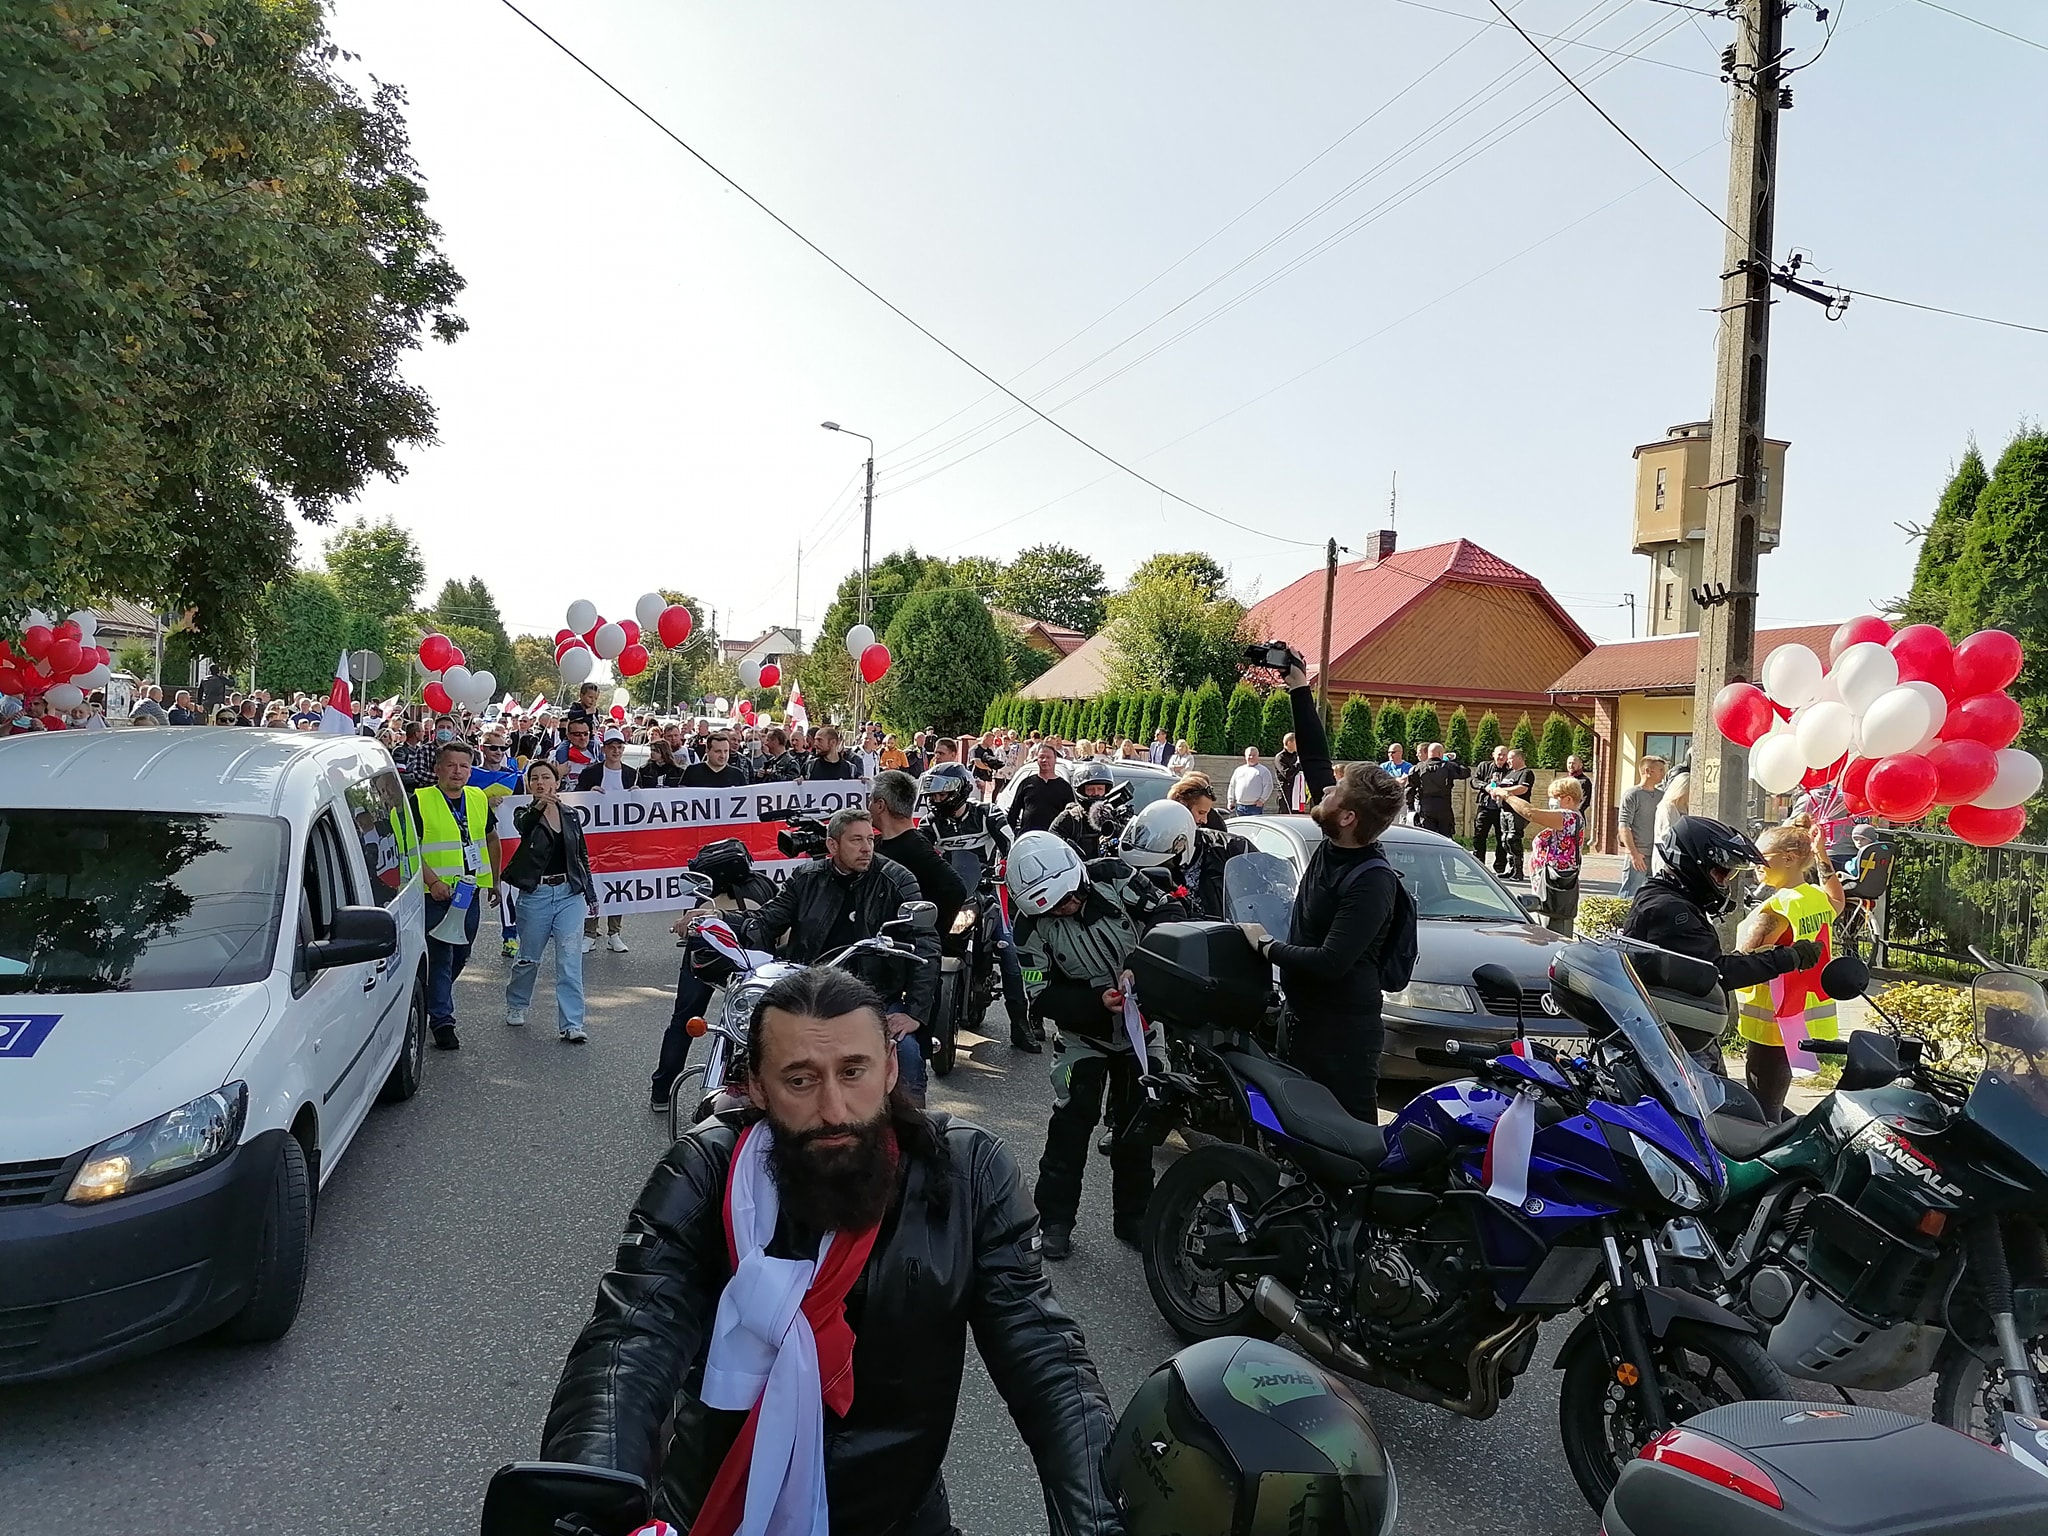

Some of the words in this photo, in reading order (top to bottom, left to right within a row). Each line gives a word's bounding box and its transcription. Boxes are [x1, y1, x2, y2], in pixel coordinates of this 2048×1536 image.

[1705, 764, 1720, 783] 27
[573, 798, 720, 827] OLIDARNI
[729, 796, 748, 818] Z
[602, 876, 682, 903] ЖЫВ
[1862, 1129, 1963, 1197] TRANSALP
[1251, 1374, 1314, 1389] SHARK
[1132, 1426, 1175, 1500] SHARK
